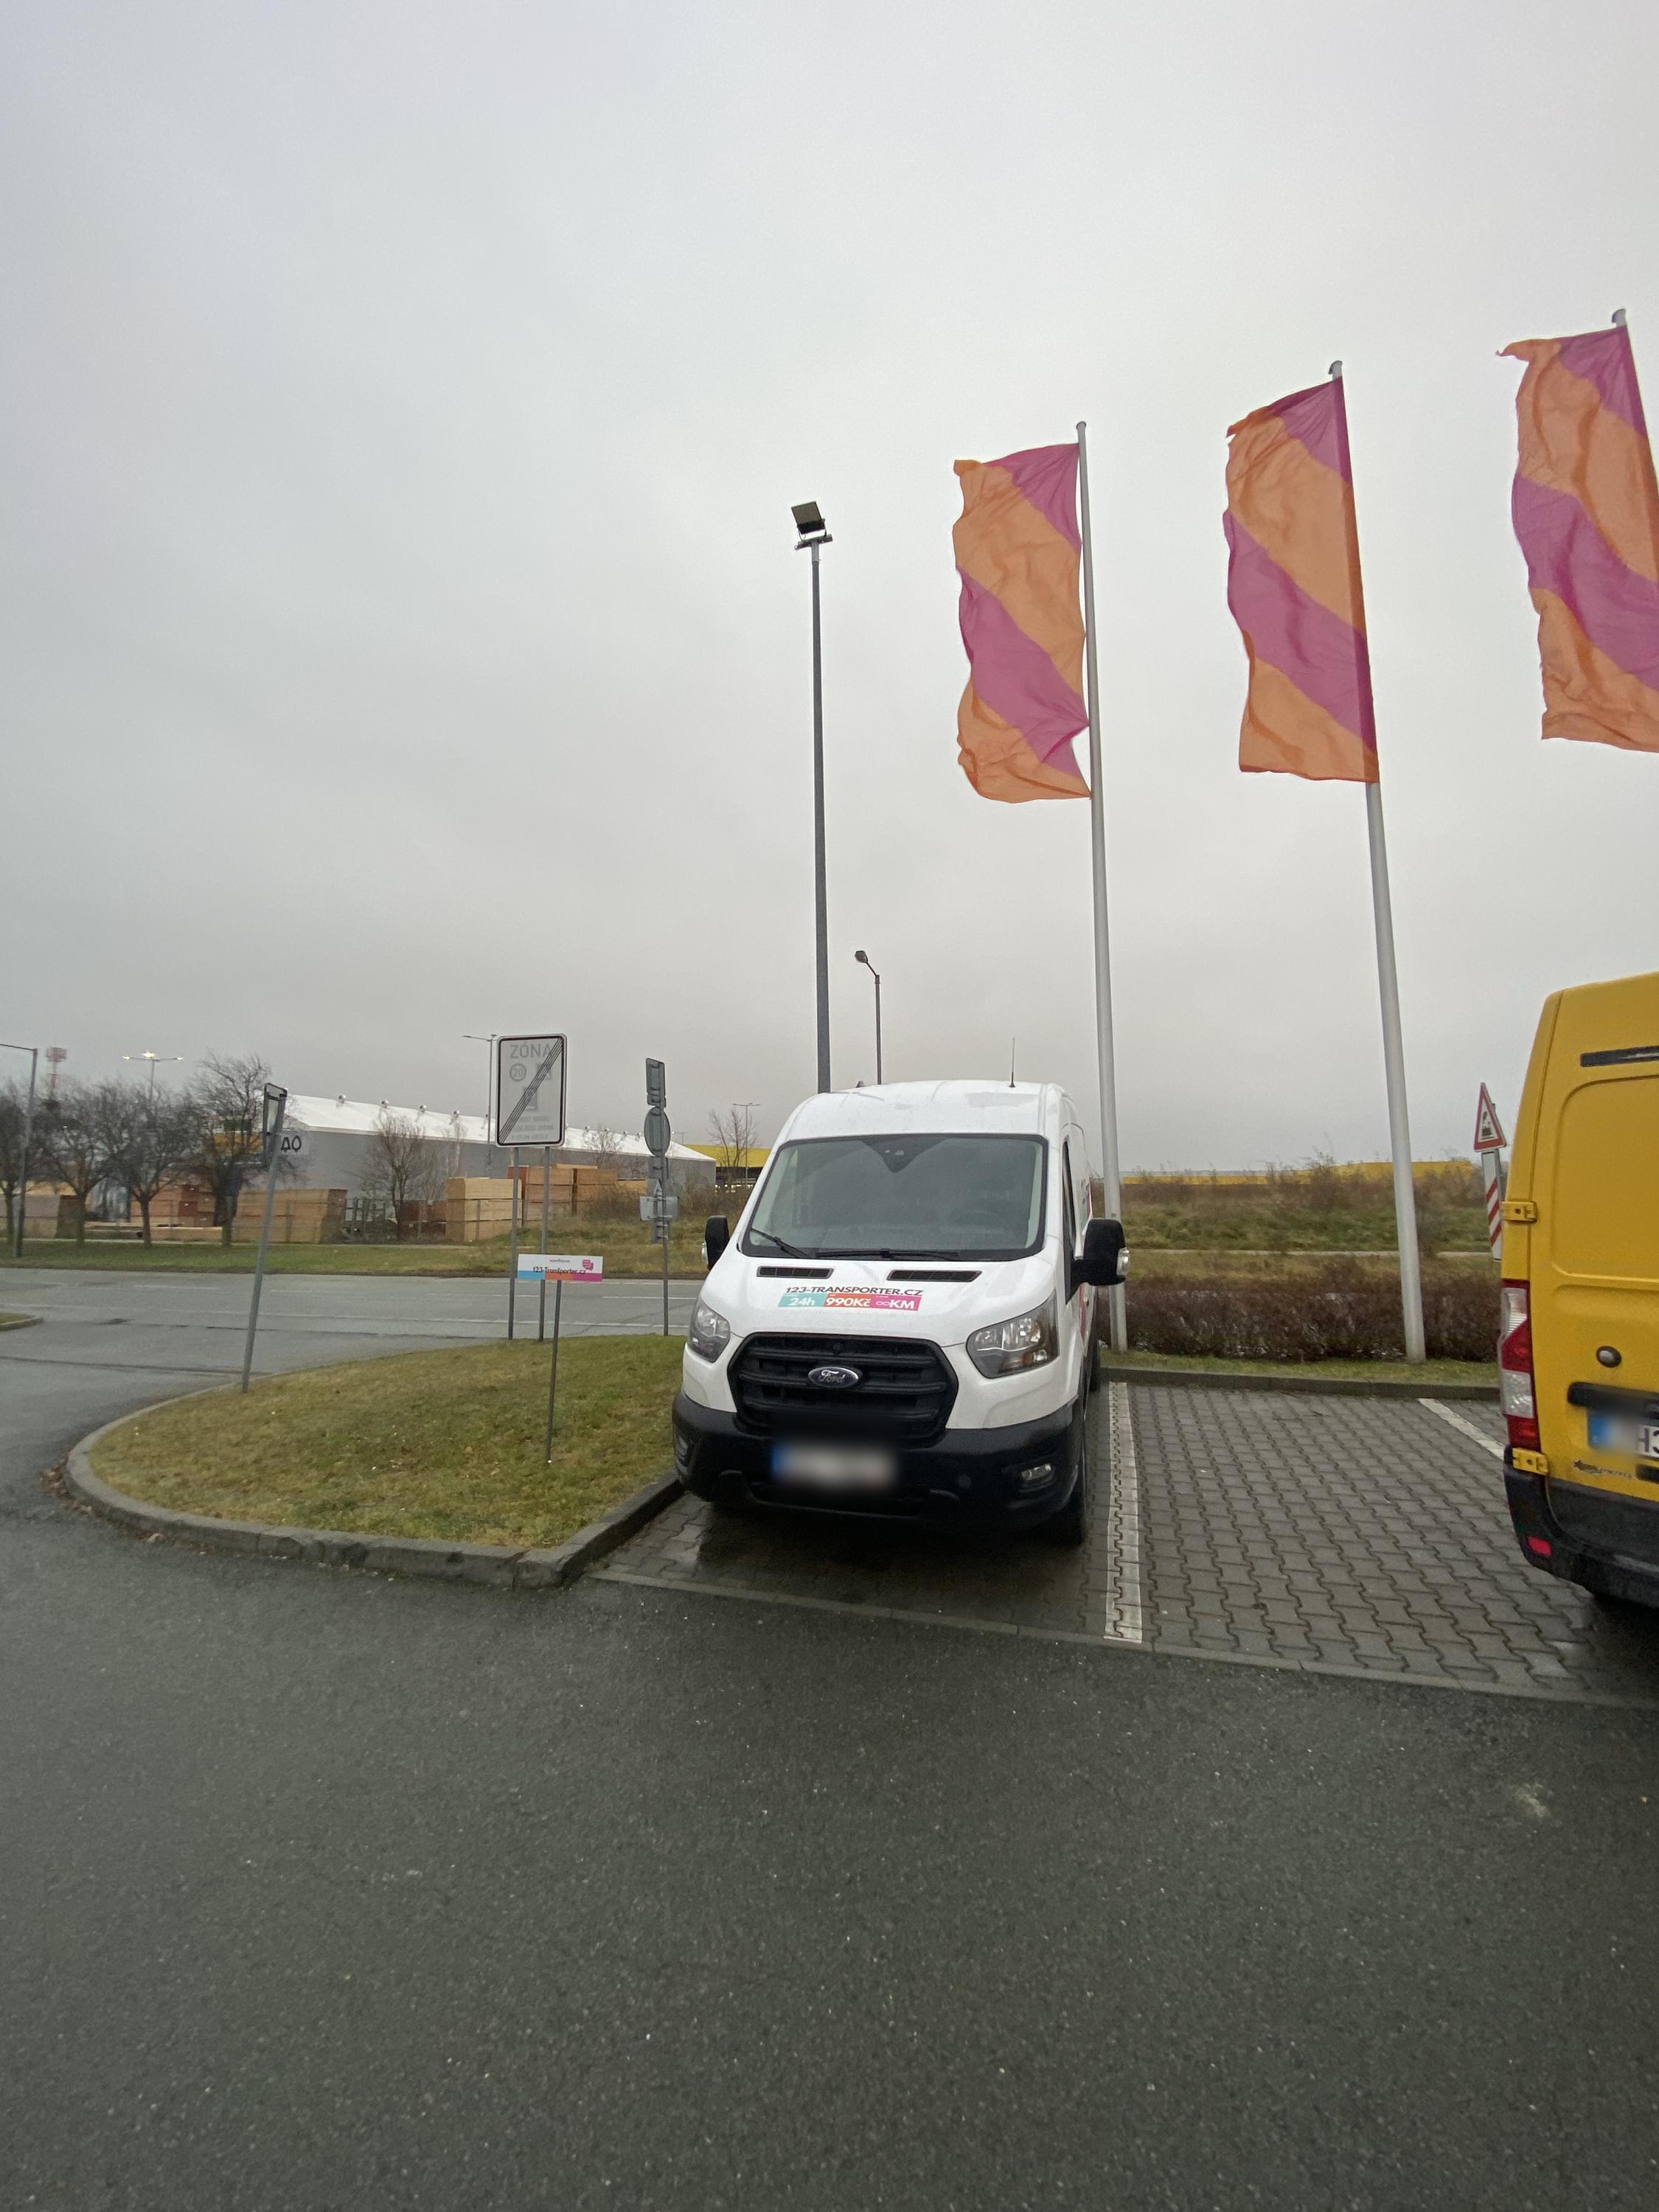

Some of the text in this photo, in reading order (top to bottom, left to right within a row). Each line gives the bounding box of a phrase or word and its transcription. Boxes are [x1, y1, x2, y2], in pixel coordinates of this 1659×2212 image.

[510, 1040, 552, 1059] ZÓNA
[786, 1286, 925, 1295] 123-TRANSPORTER.CZ
[789, 1296, 815, 1307] 24h
[825, 1296, 872, 1307] 990Kč
[818, 1370, 846, 1383] Ford
